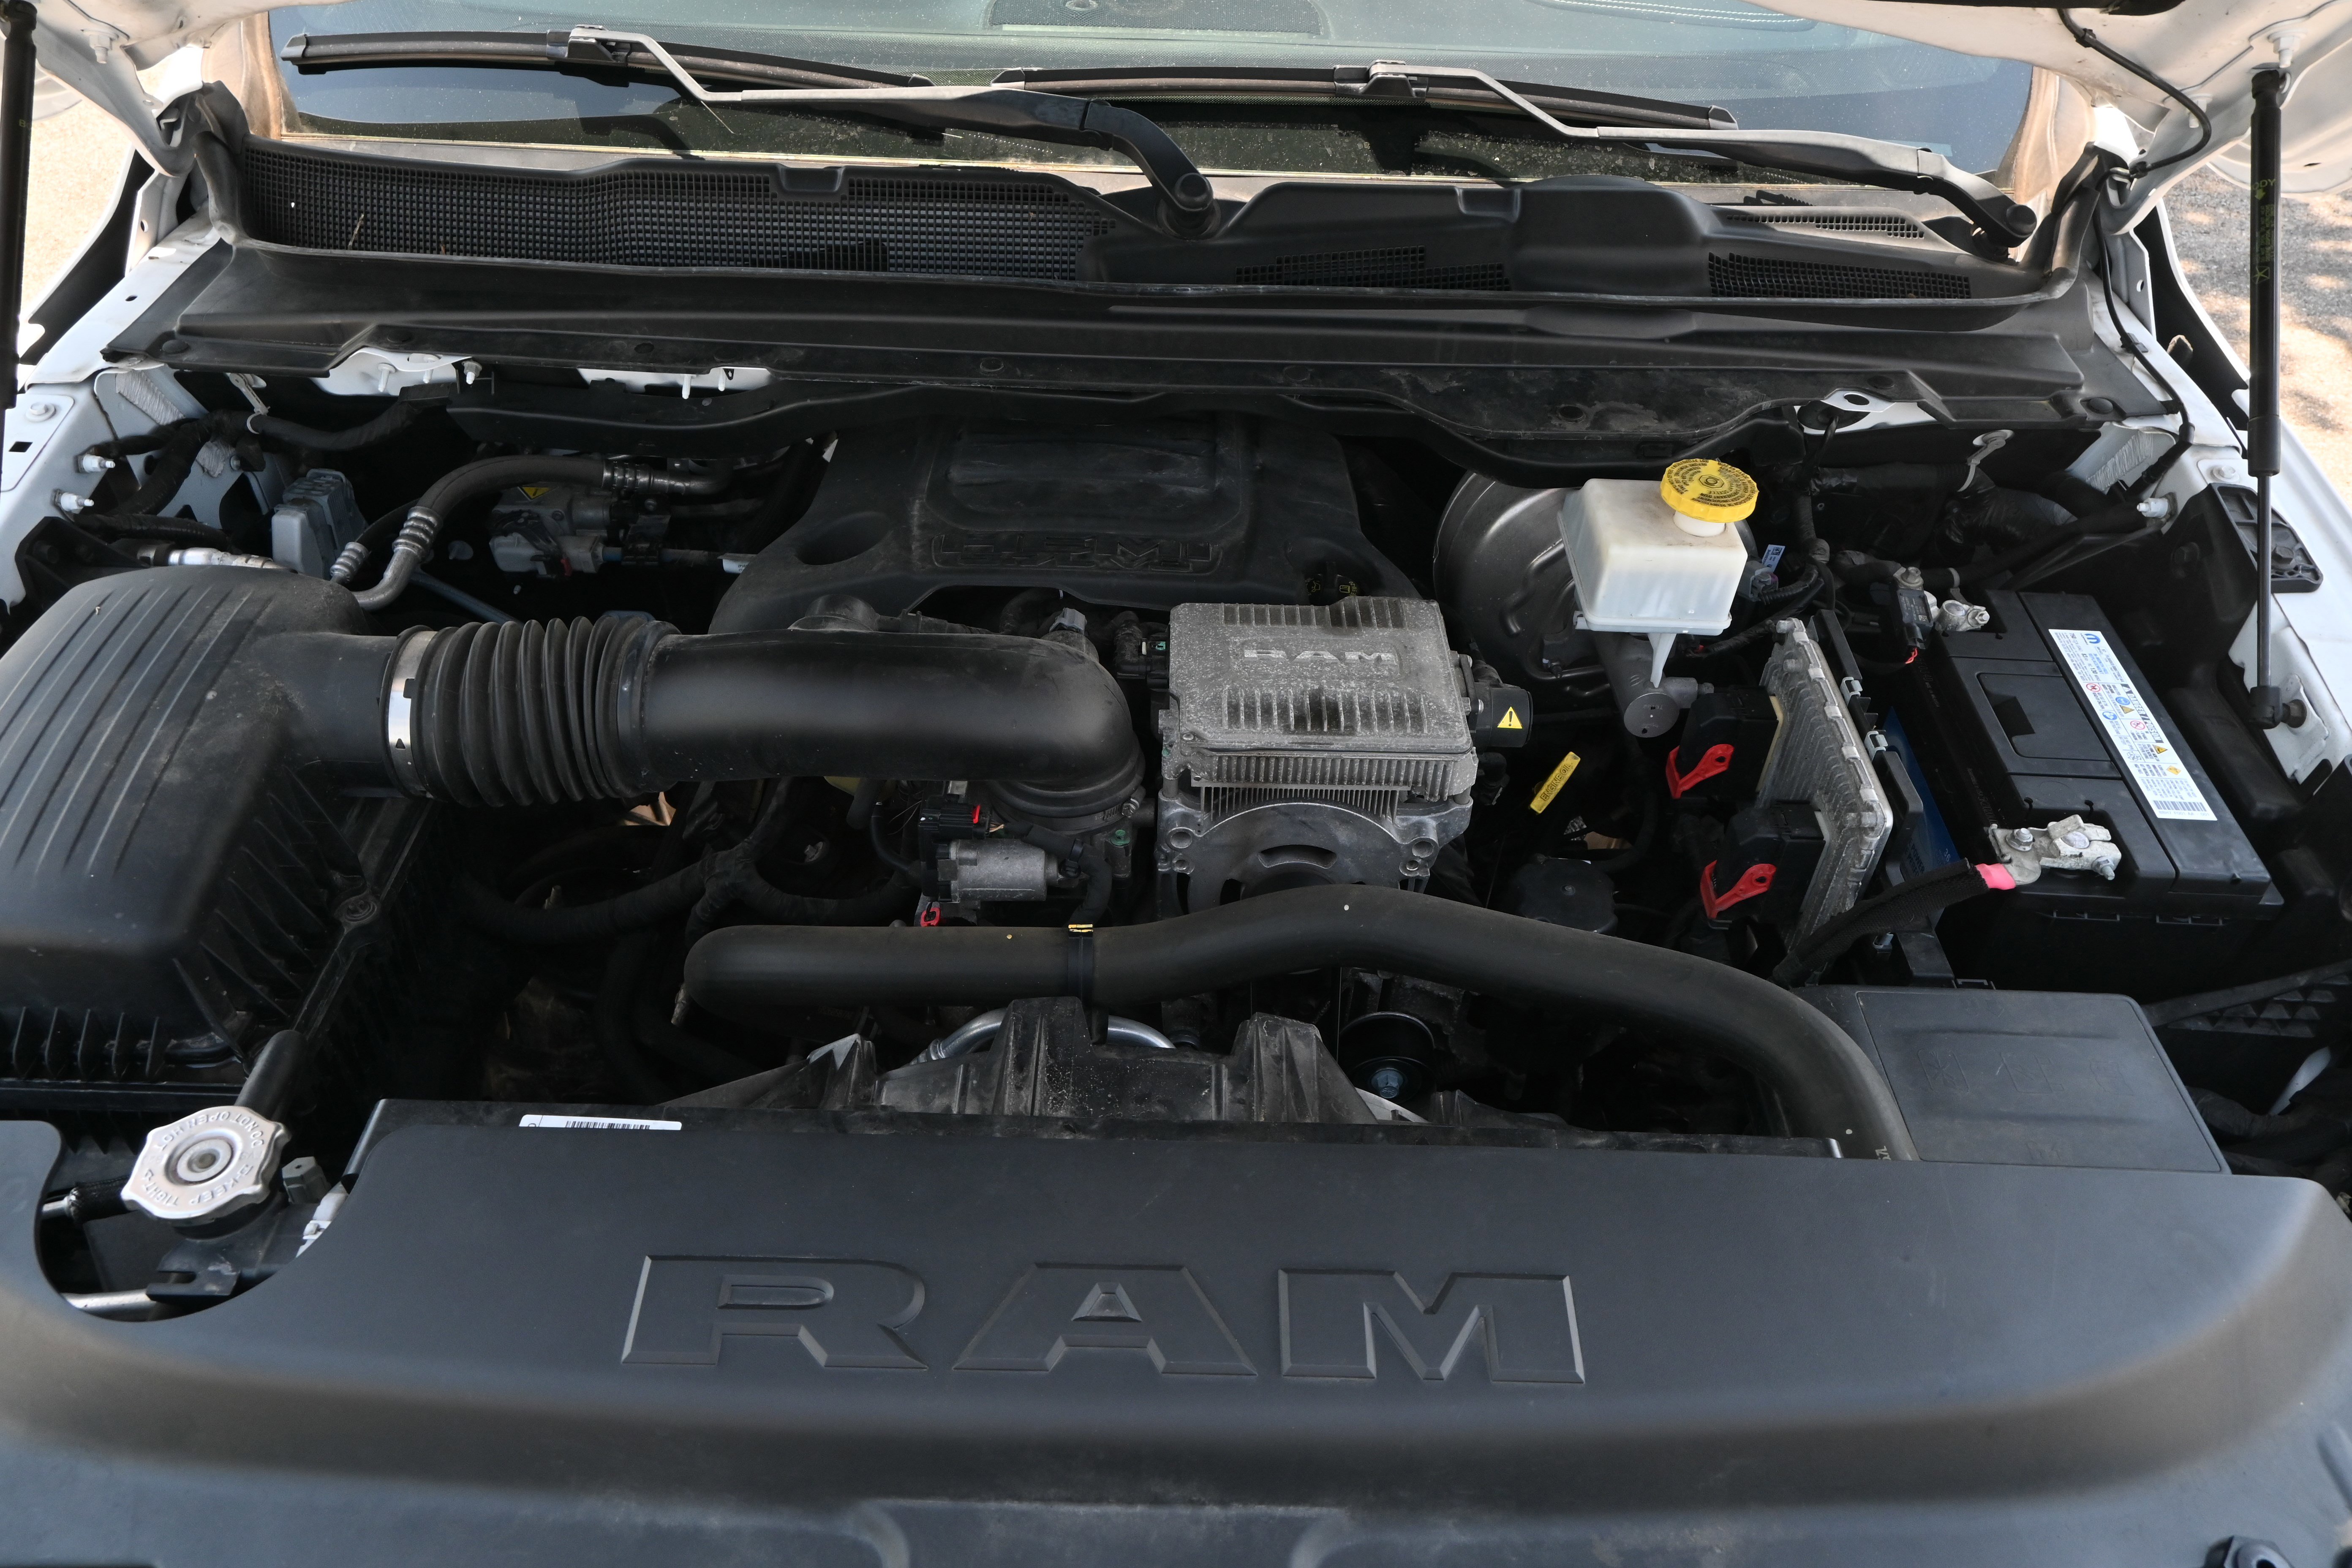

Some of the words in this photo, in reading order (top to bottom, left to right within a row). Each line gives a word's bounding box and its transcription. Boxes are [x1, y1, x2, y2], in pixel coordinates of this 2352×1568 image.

[1244, 649, 1399, 665] RAM
[2126, 693, 2146, 714] DANGER
[2142, 720, 2162, 740] POISON
[1541, 774, 1563, 801] ENGINE
[1560, 764, 1571, 776] OIL
[185, 1112, 229, 1127] OPEN
[229, 1113, 259, 1132] NOT
[153, 1126, 184, 1151] HOT
[250, 1130, 264, 1149] DO
[144, 1182, 179, 1206] TIGHT
[190, 1179, 239, 1204] KEEP
[621, 1254, 1586, 1383] RAM
